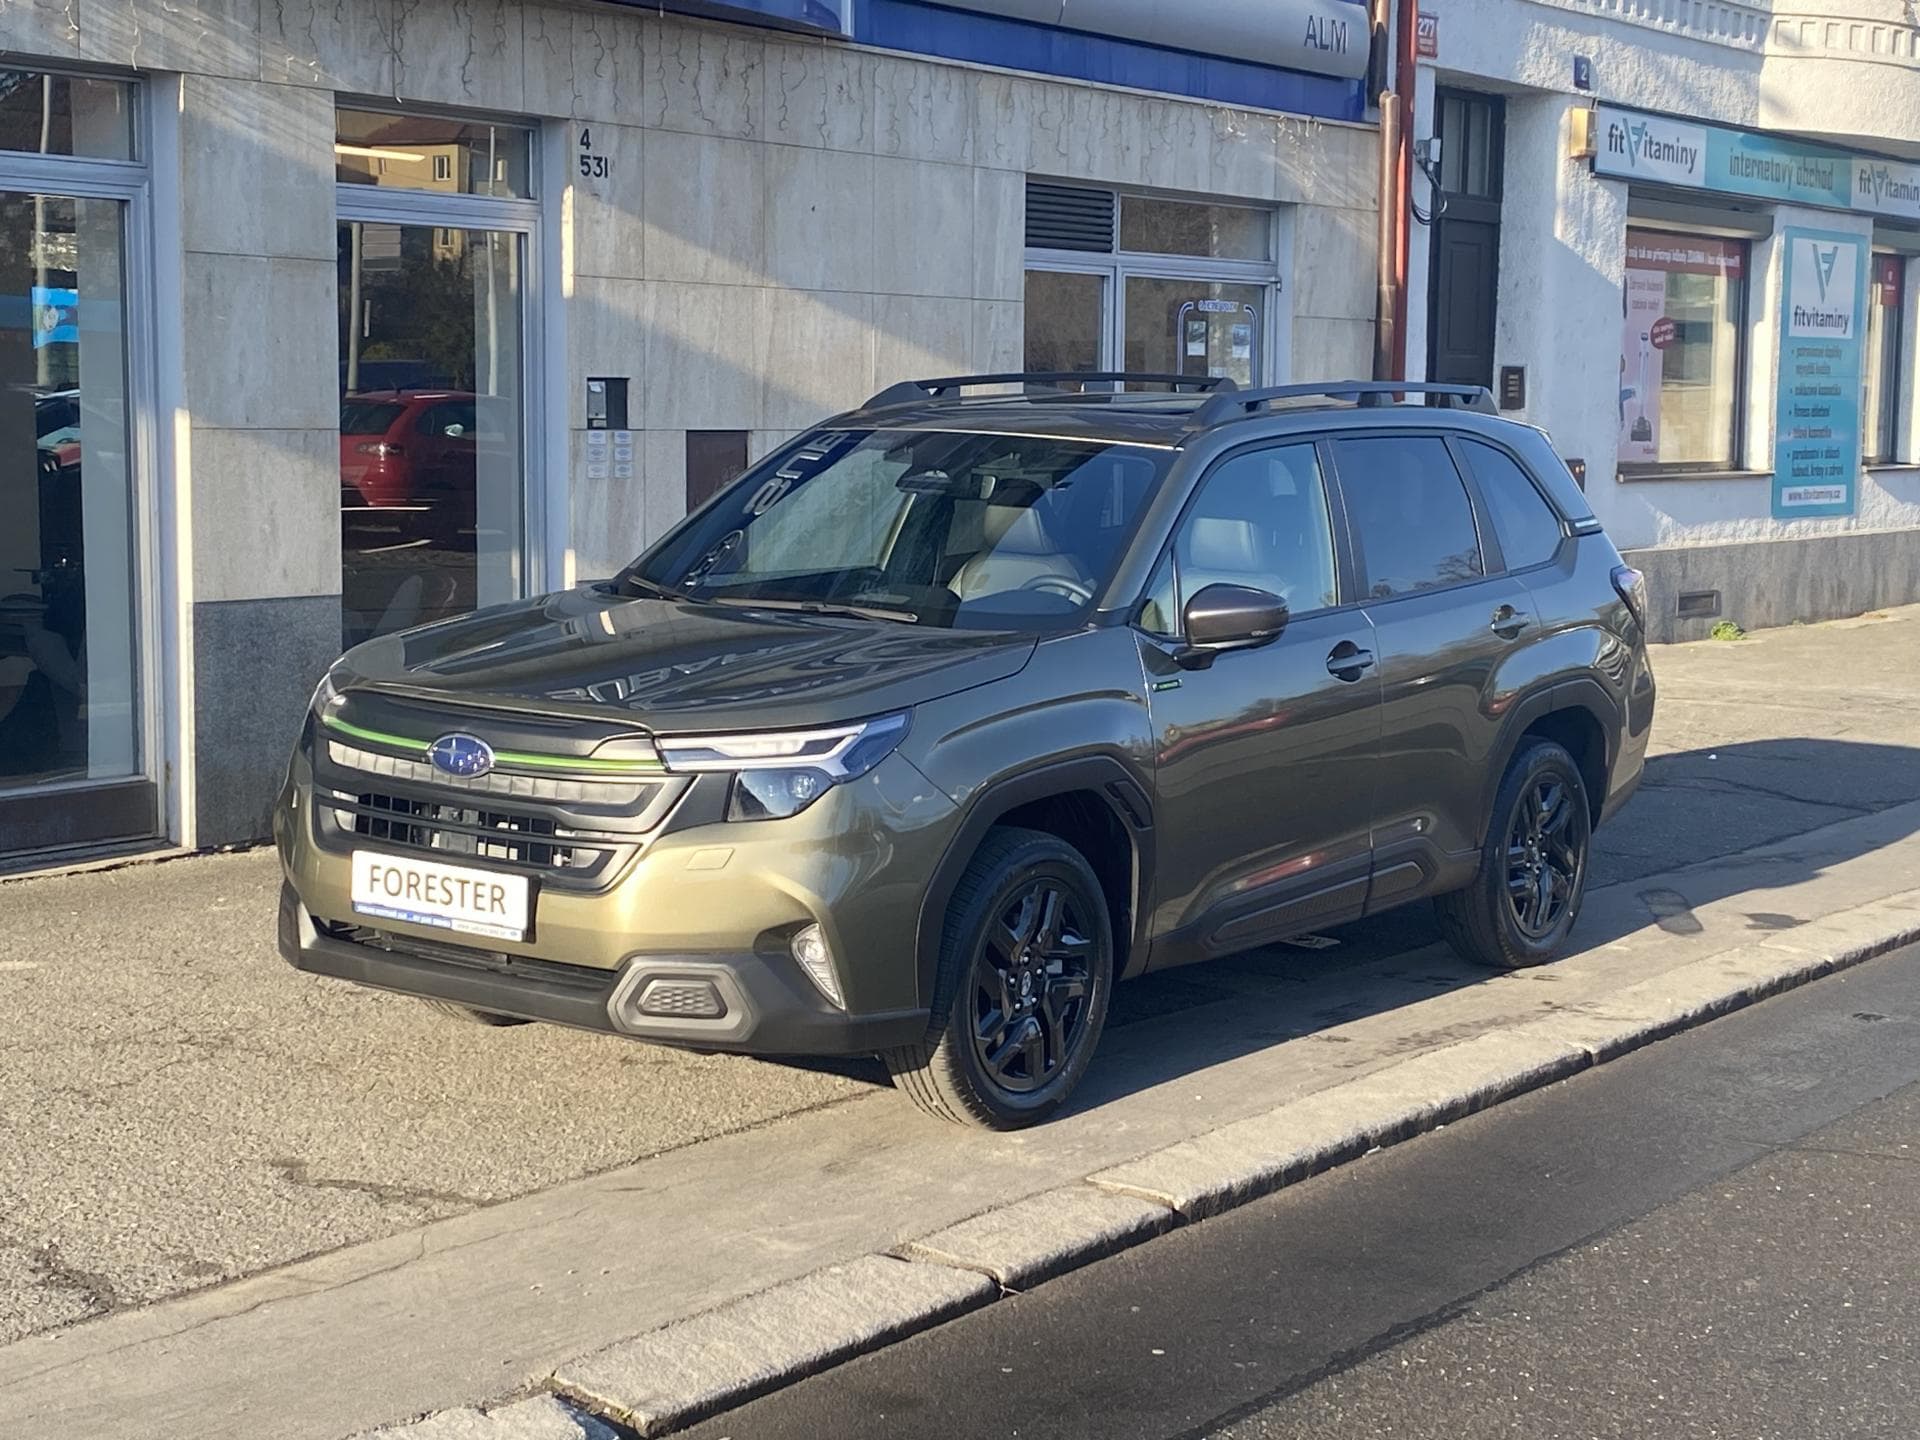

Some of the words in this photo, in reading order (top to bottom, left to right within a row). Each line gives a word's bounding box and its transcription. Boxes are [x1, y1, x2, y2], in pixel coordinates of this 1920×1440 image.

[1304, 15, 1347, 54] ALM
[1581, 63, 1588, 81] 2
[580, 128, 591, 150] 4
[580, 154, 608, 178] 531
[1794, 305, 1850, 335] fitvitaminy
[369, 864, 507, 915] FORESTER
